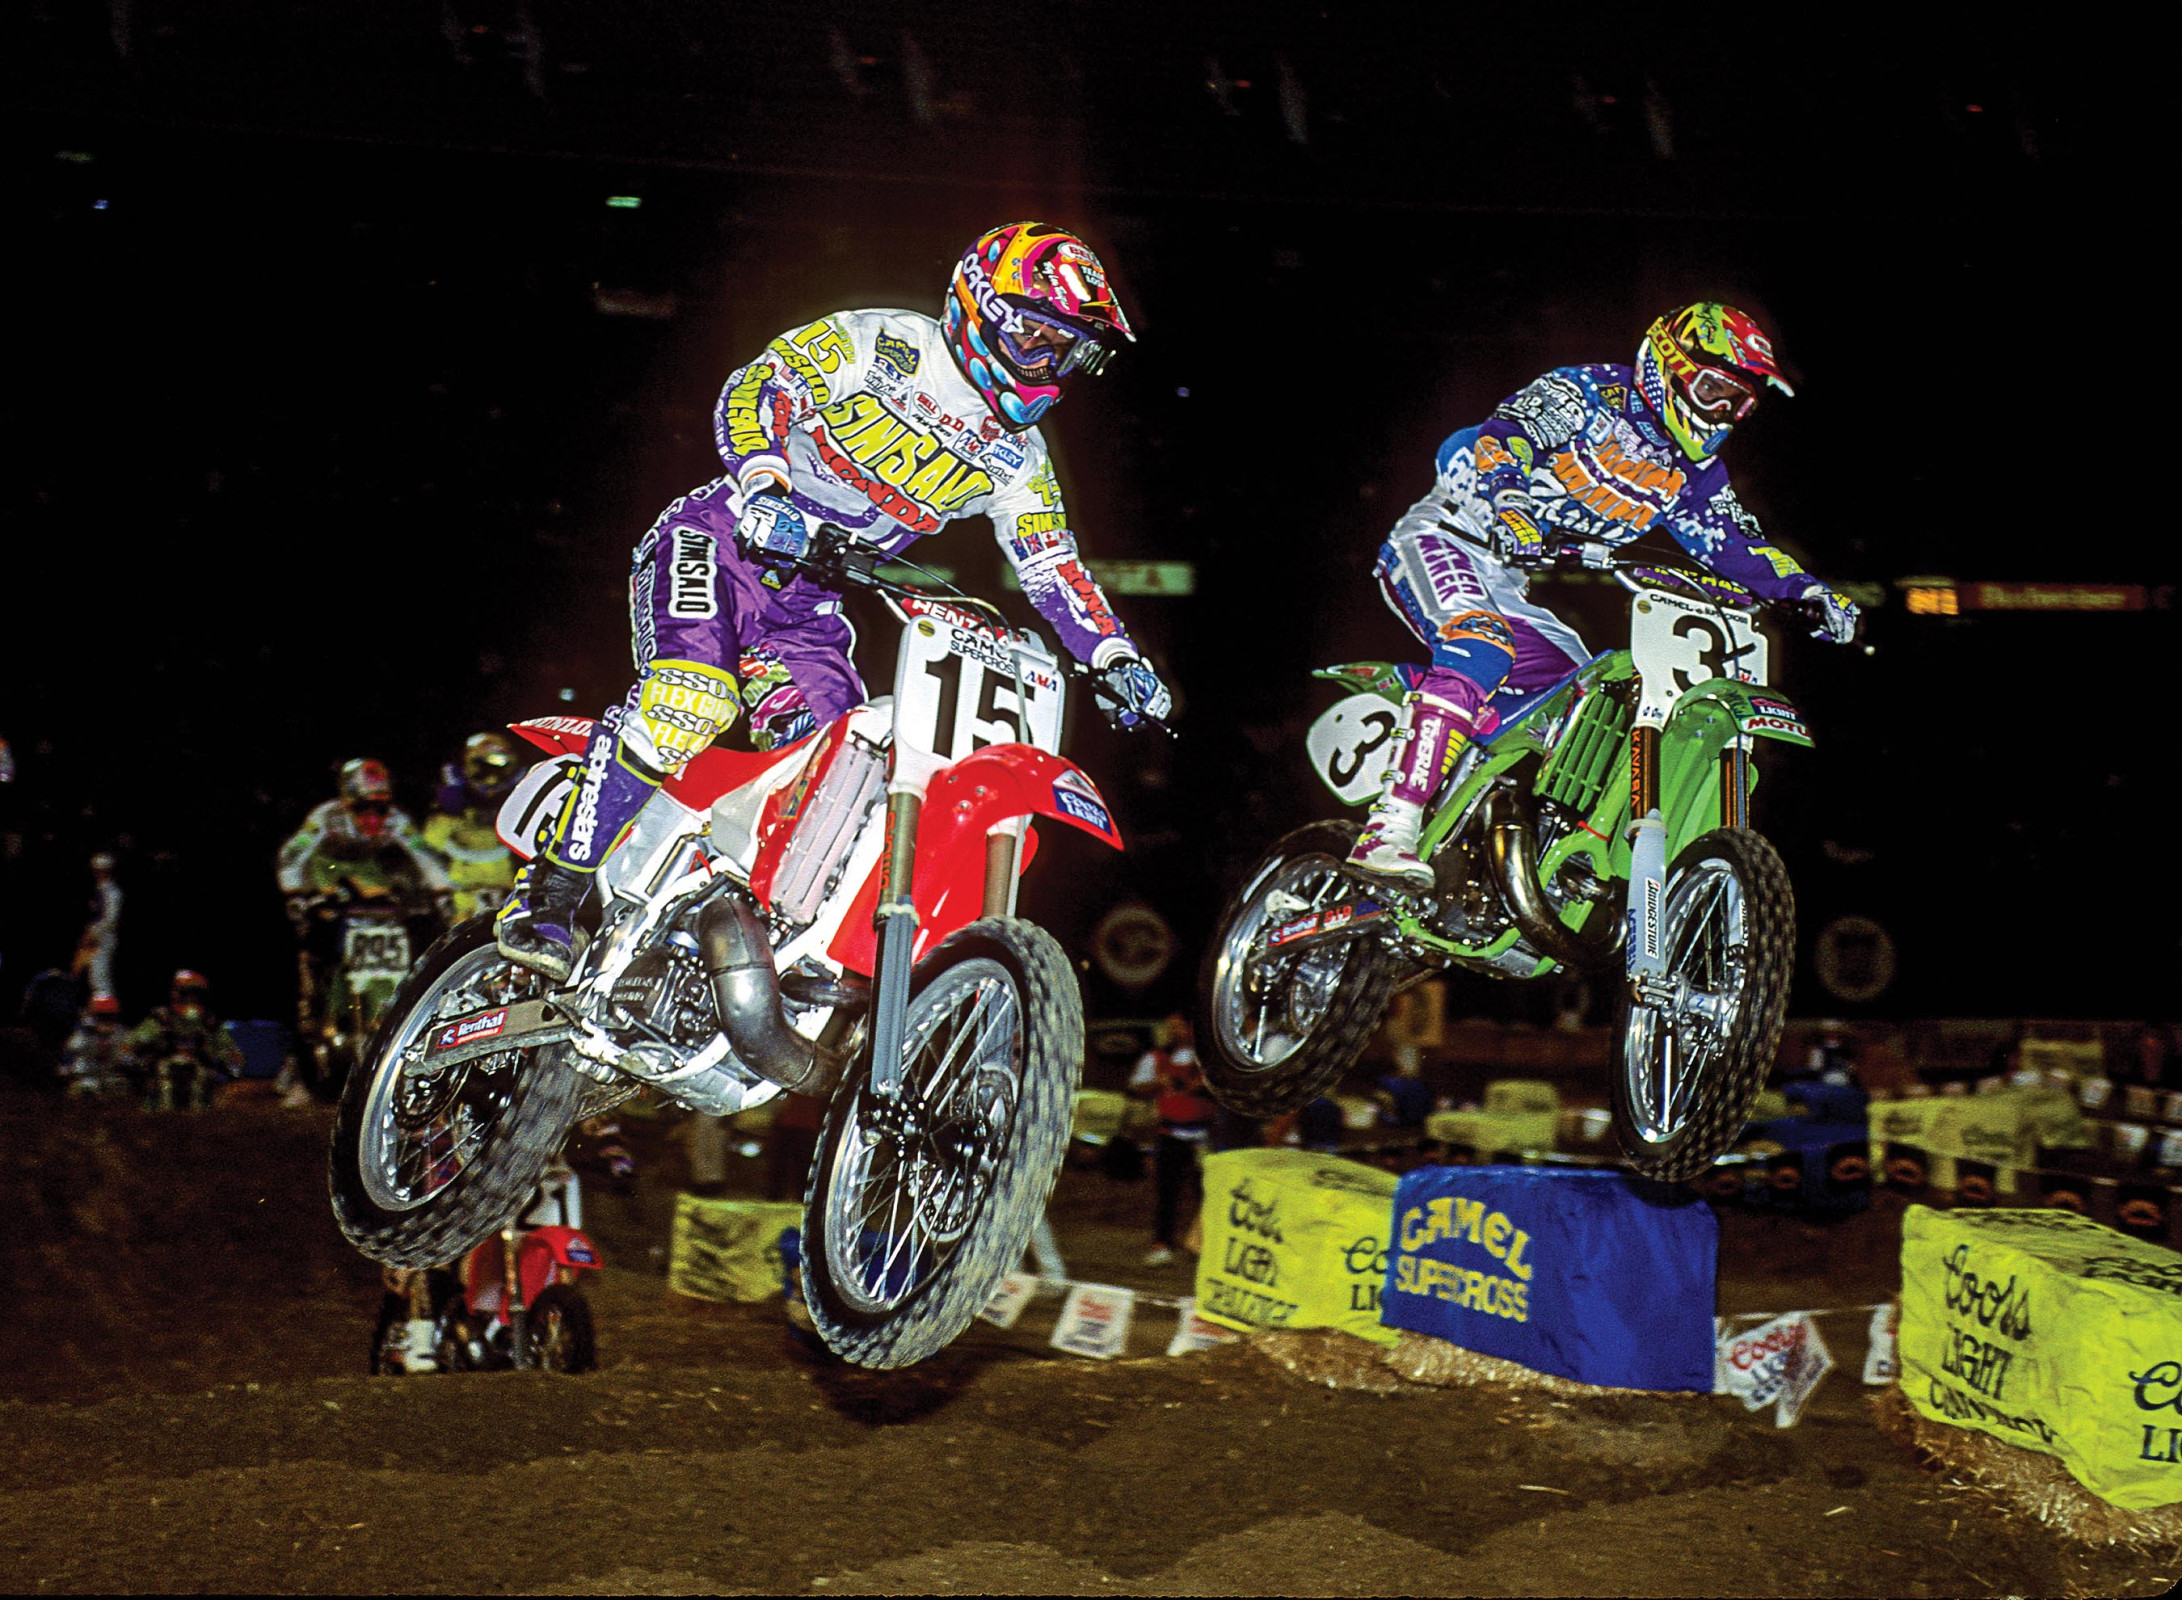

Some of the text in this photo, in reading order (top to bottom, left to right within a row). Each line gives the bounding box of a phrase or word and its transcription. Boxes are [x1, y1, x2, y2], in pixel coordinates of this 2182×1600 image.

[963, 252, 1025, 335] OAKLEY
[766, 337, 831, 406] NISALO
[791, 319, 840, 374] 15
[876, 336, 917, 366] CAMEL
[1649, 320, 1698, 377] SCOTT
[917, 392, 938, 415] BELL
[993, 445, 1022, 466] KLEY
[1650, 593, 1694, 612] CAMEL
[1024, 669, 1058, 692] AMA
[1672, 613, 1727, 693] 3
[650, 681, 699, 713] FLEX
[924, 650, 1036, 763] 15
[1759, 705, 1797, 720] LIGHT
[1329, 710, 1396, 787] 3
[568, 733, 613, 861] alpinestars
[1057, 790, 1109, 823] Coors
[1645, 876, 1662, 959] BRIDGESTONE
[458, 1011, 505, 1037] Renthal
[1400, 1196, 1534, 1281] CAMEL
